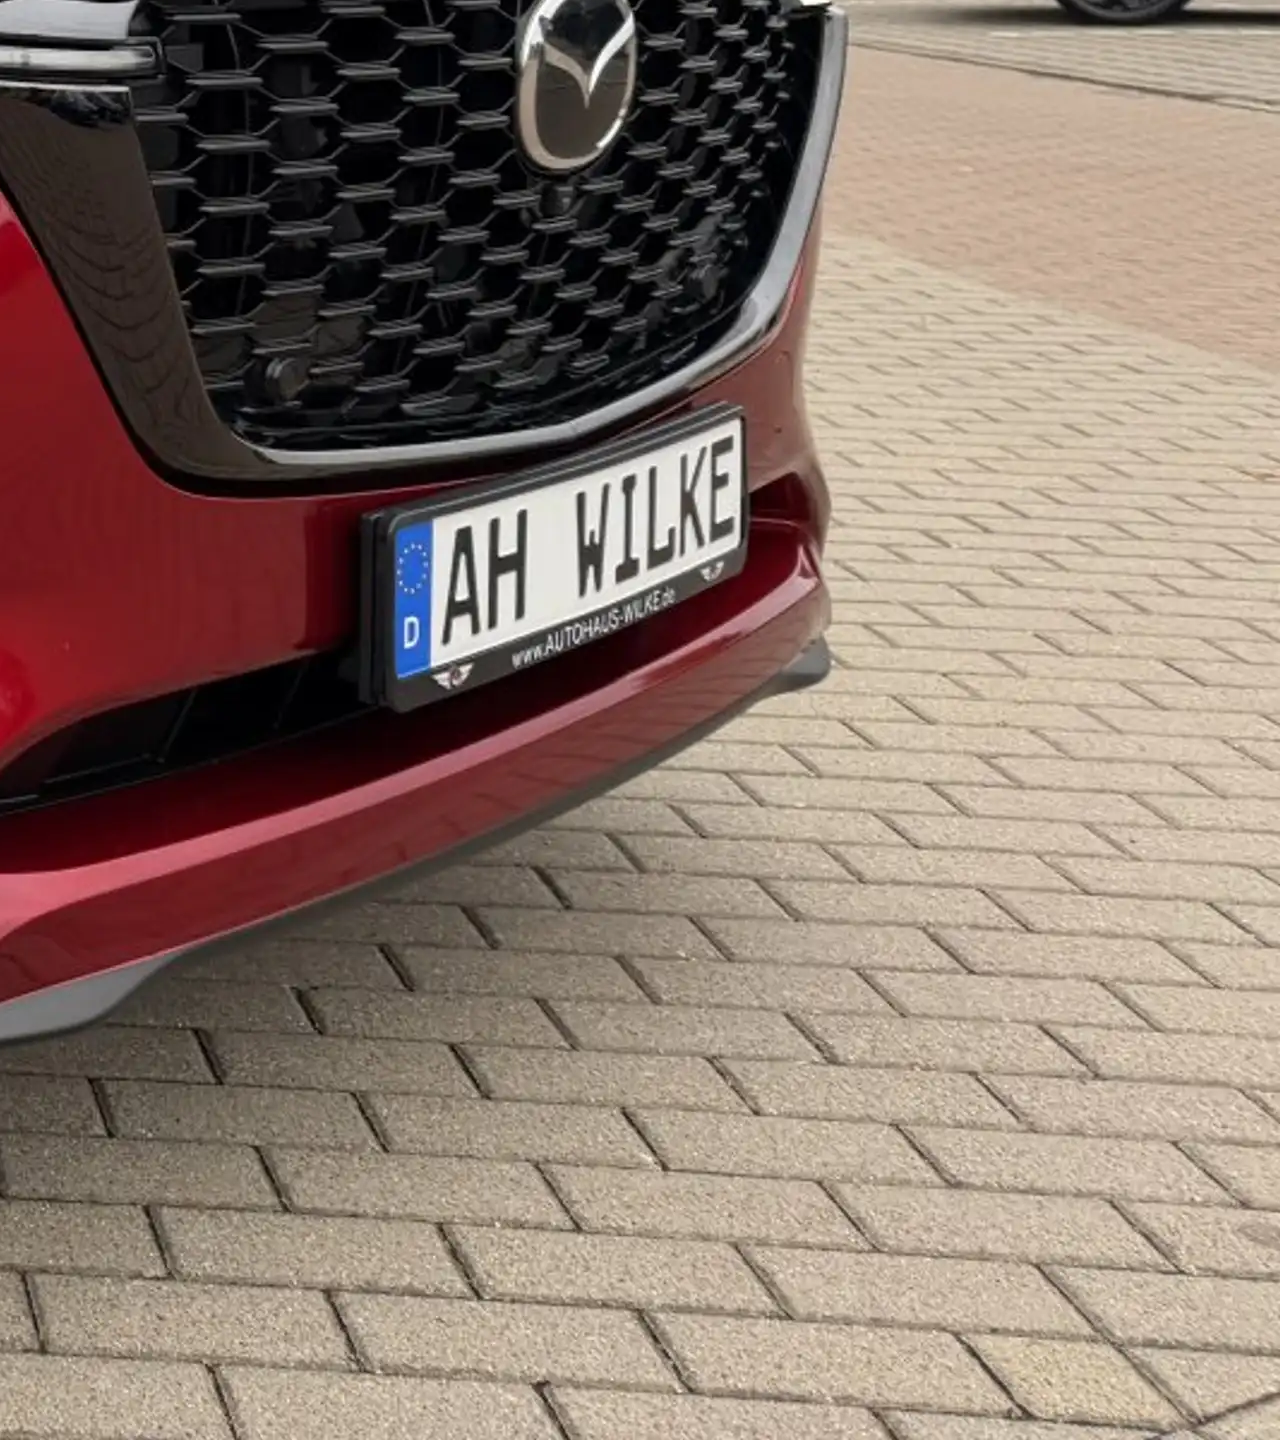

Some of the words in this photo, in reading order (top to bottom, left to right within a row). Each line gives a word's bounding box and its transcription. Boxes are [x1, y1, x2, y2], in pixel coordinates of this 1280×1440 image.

[441, 507, 529, 647] AH
[576, 434, 735, 598] WILKE
[403, 615, 420, 650] D
[511, 585, 676, 669] www.AUTOHAUS-WILKE.de
